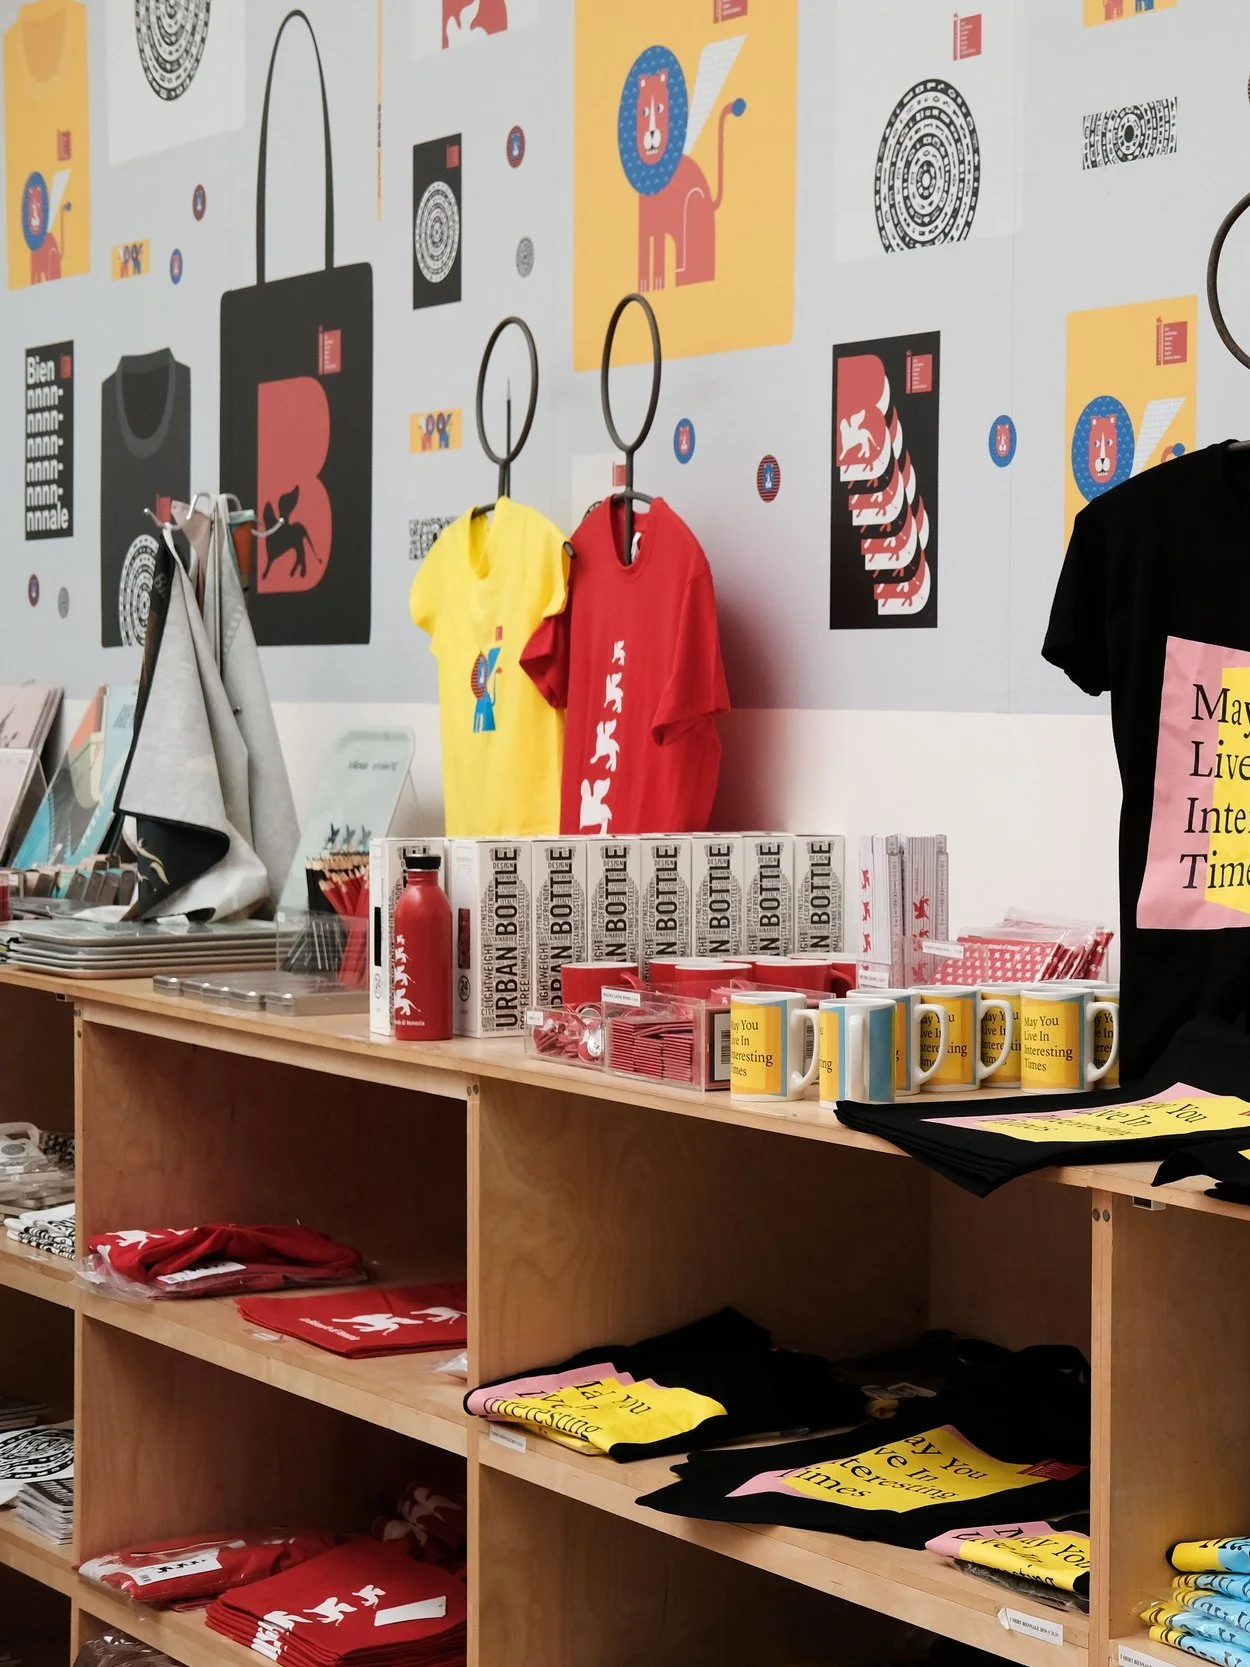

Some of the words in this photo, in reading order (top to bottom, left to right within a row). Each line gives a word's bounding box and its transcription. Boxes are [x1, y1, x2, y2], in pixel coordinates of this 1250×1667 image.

[27, 356, 55, 384] Bien
[27, 502, 68, 532] nnnale
[495, 848, 517, 935] BOTTLE
[550, 848, 572, 934] BOTTLE
[605, 846, 627, 932] BOTTLE
[656, 846, 677, 931] BOTTLE
[709, 845, 730, 929] BOTTLE
[760, 844, 780, 927] BOTTLE
[810, 842, 831, 924] BOTTLE
[484, 944, 493, 1008] LIGHTWEIGHT
[495, 946, 517, 1028] URBAN
[520, 980, 529, 1006] FREE
[741, 1020, 759, 1031] You
[999, 1012, 1019, 1021] Yu
[1024, 1016, 1038, 1027] May
[1039, 1016, 1059, 1026] You
[741, 1035, 750, 1046] In
[1024, 1030, 1037, 1041] Live
[1040, 1030, 1049, 1041] In
[732, 1050, 773, 1066] nteresting
[1024, 1044, 1073, 1060] Interesting
[1024, 1058, 1047, 1071] Times
[1126, 1114, 1152, 1127] In
[1168, 1104, 1207, 1123] You
[874, 1447, 908, 1469] ve
[905, 1468, 939, 1482] In
[904, 1435, 942, 1456] ay
[939, 1456, 989, 1480] You
[840, 1457, 959, 1499] teresting
